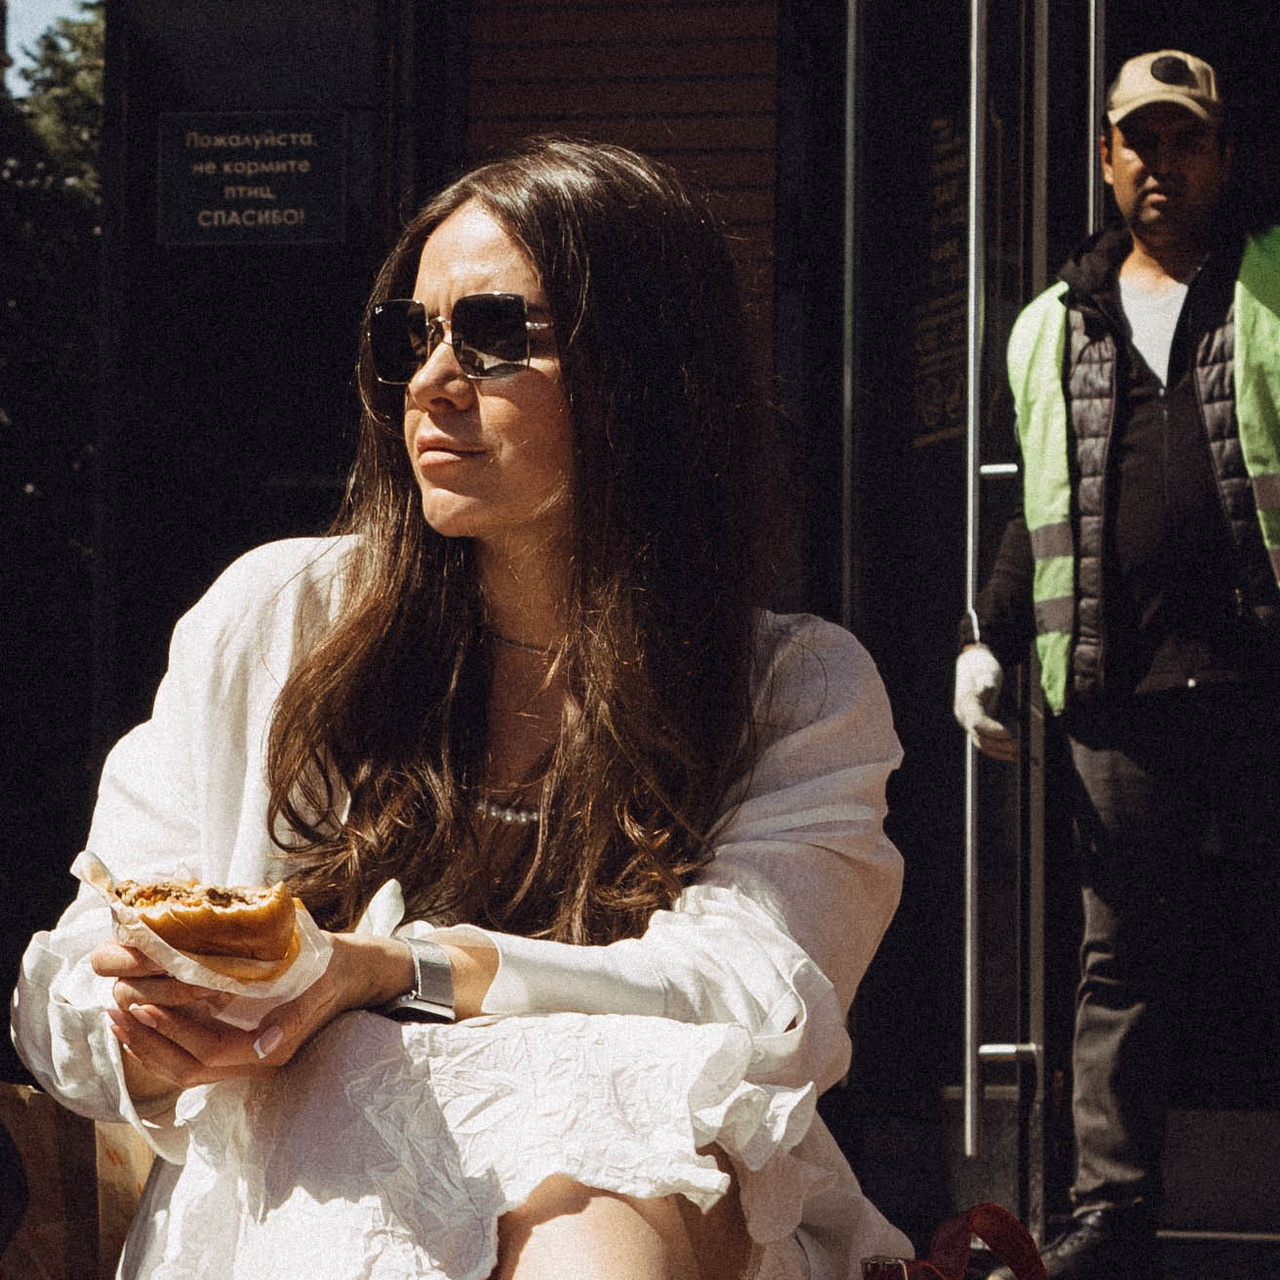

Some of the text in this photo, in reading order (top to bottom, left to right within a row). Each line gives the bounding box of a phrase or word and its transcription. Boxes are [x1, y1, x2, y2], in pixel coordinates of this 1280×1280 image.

[191, 160, 311, 177] не кормите
[197, 208, 305, 227] СПАСИБО!
